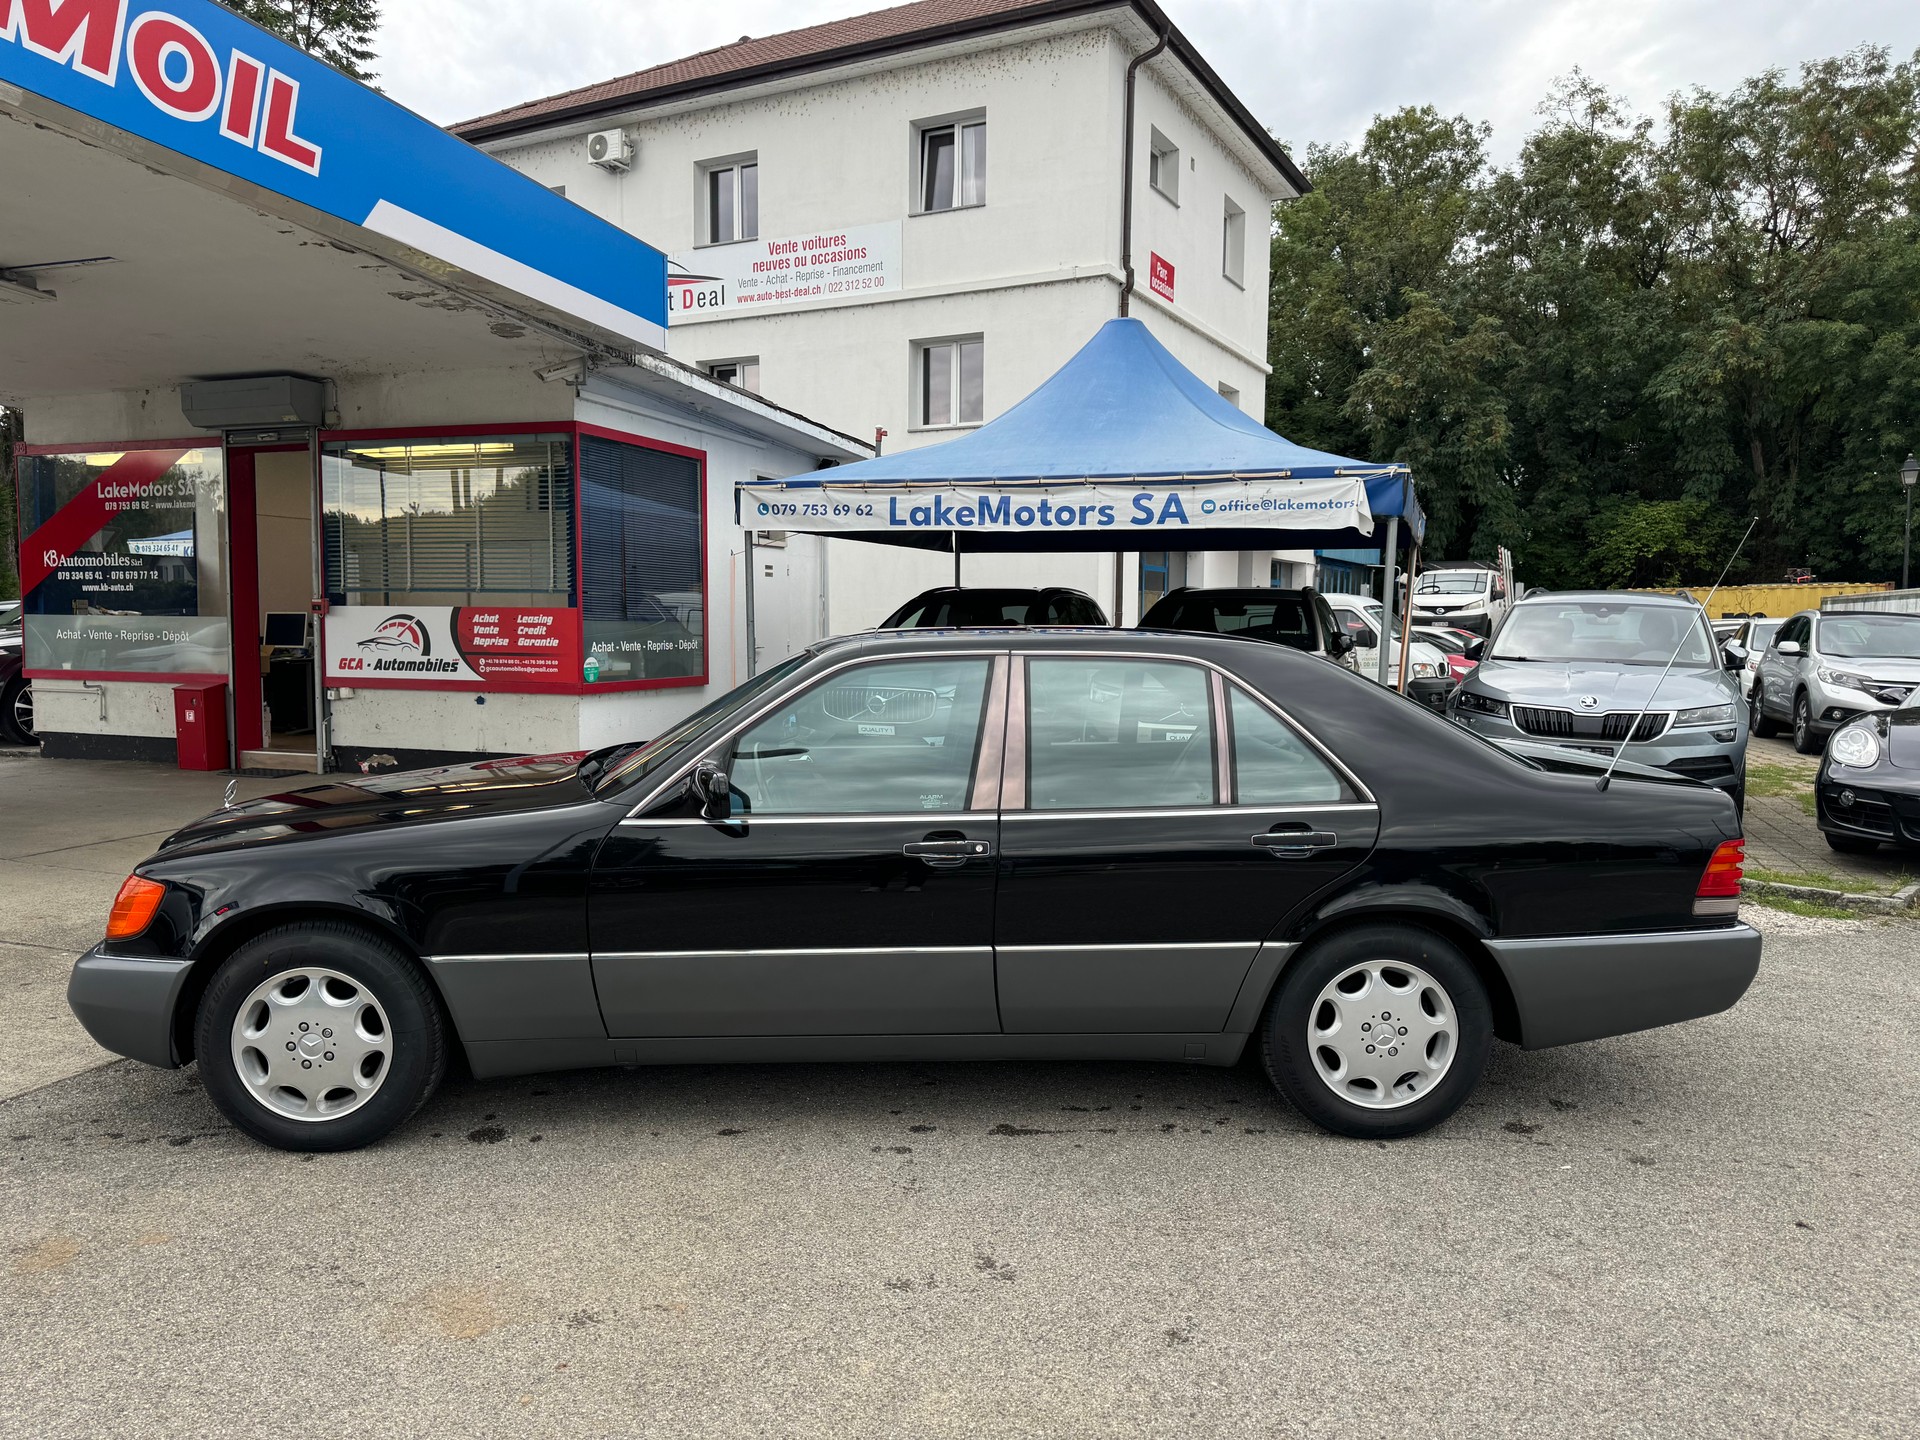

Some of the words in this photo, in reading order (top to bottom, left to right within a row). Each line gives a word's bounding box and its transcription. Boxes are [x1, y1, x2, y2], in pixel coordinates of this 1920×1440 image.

[768, 240, 798, 256] Vente
[802, 234, 847, 251] voitures
[752, 258, 790, 273] neuves
[794, 255, 807, 268] ou
[811, 247, 867, 266] occasions
[737, 278, 758, 289] Vente
[766, 273, 788, 286] Achat
[795, 268, 825, 283] Reprise
[832, 260, 884, 278] Financement
[683, 284, 725, 309] Deal
[736, 284, 821, 304] www.auto-best-deal.ch
[828, 281, 843, 294] 022
[845, 279, 860, 291] 312
[862, 277, 872, 289] 52
[874, 276, 885, 288] 00
[97, 481, 174, 498] LakeMotors
[178, 479, 195, 496] SA
[105, 501, 117, 510] 079
[118, 501, 130, 510] 753
[131, 501, 140, 509] 69
[141, 500, 150, 509] 62
[771, 504, 797, 516] 079
[802, 504, 828, 516] 753
[833, 504, 850, 516] 69
[855, 504, 873, 516] 62
[889, 495, 1115, 527] LakeMotors
[1130, 493, 1190, 525] SA
[57, 571, 70, 580] 079
[71, 571, 83, 580] 334
[85, 571, 94, 580] 65
[94, 571, 103, 580] 41
[111, 571, 124, 580] 076
[125, 571, 138, 579] 679
[139, 571, 148, 579] 77
[149, 571, 159, 579] 12
[82, 583, 134, 592] www.kb-auto.ch
[472, 613, 500, 623] Achat
[517, 614, 554, 626] Leasing
[56, 629, 81, 640] Achat
[88, 629, 113, 640] Vente
[120, 630, 155, 643] Reprise
[162, 630, 190, 643] Dépôt
[473, 625, 500, 634] Vente
[517, 626, 547, 635] Credit
[473, 637, 510, 648] Reprise
[517, 637, 559, 647] Garantie
[591, 641, 615, 653] Achat
[620, 641, 641, 652] Vente
[647, 640, 674, 652] Reprise
[678, 639, 698, 651] Dépôt
[338, 658, 363, 670] GCA
[373, 658, 459, 673] Automobiles
